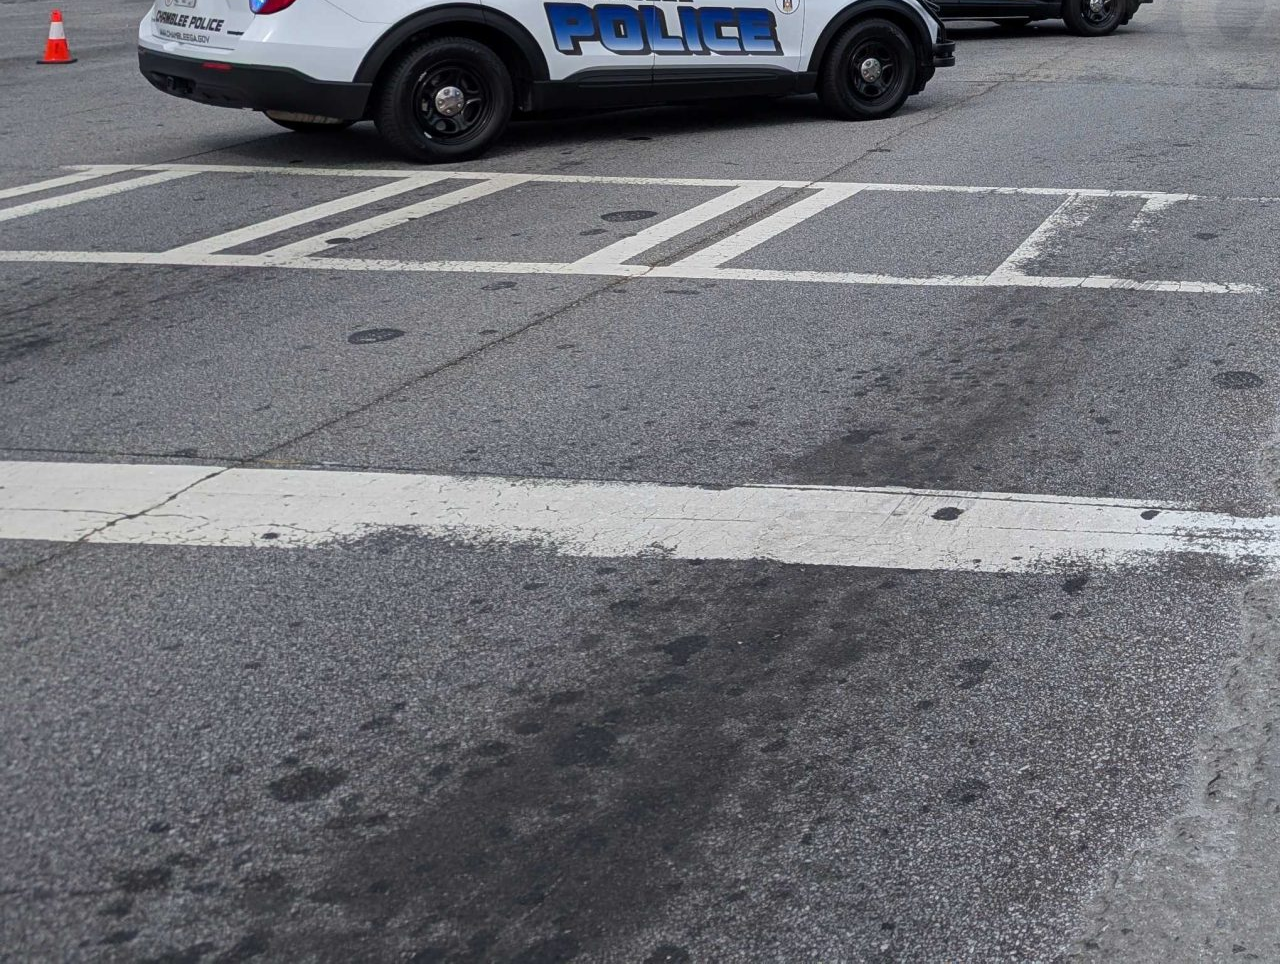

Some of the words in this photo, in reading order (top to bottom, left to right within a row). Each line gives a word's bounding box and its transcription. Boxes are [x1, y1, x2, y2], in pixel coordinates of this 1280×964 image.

[156, 10, 189, 28] CHAMBLEE
[188, 16, 225, 32] POLICE
[543, 2, 784, 56] POLICE
